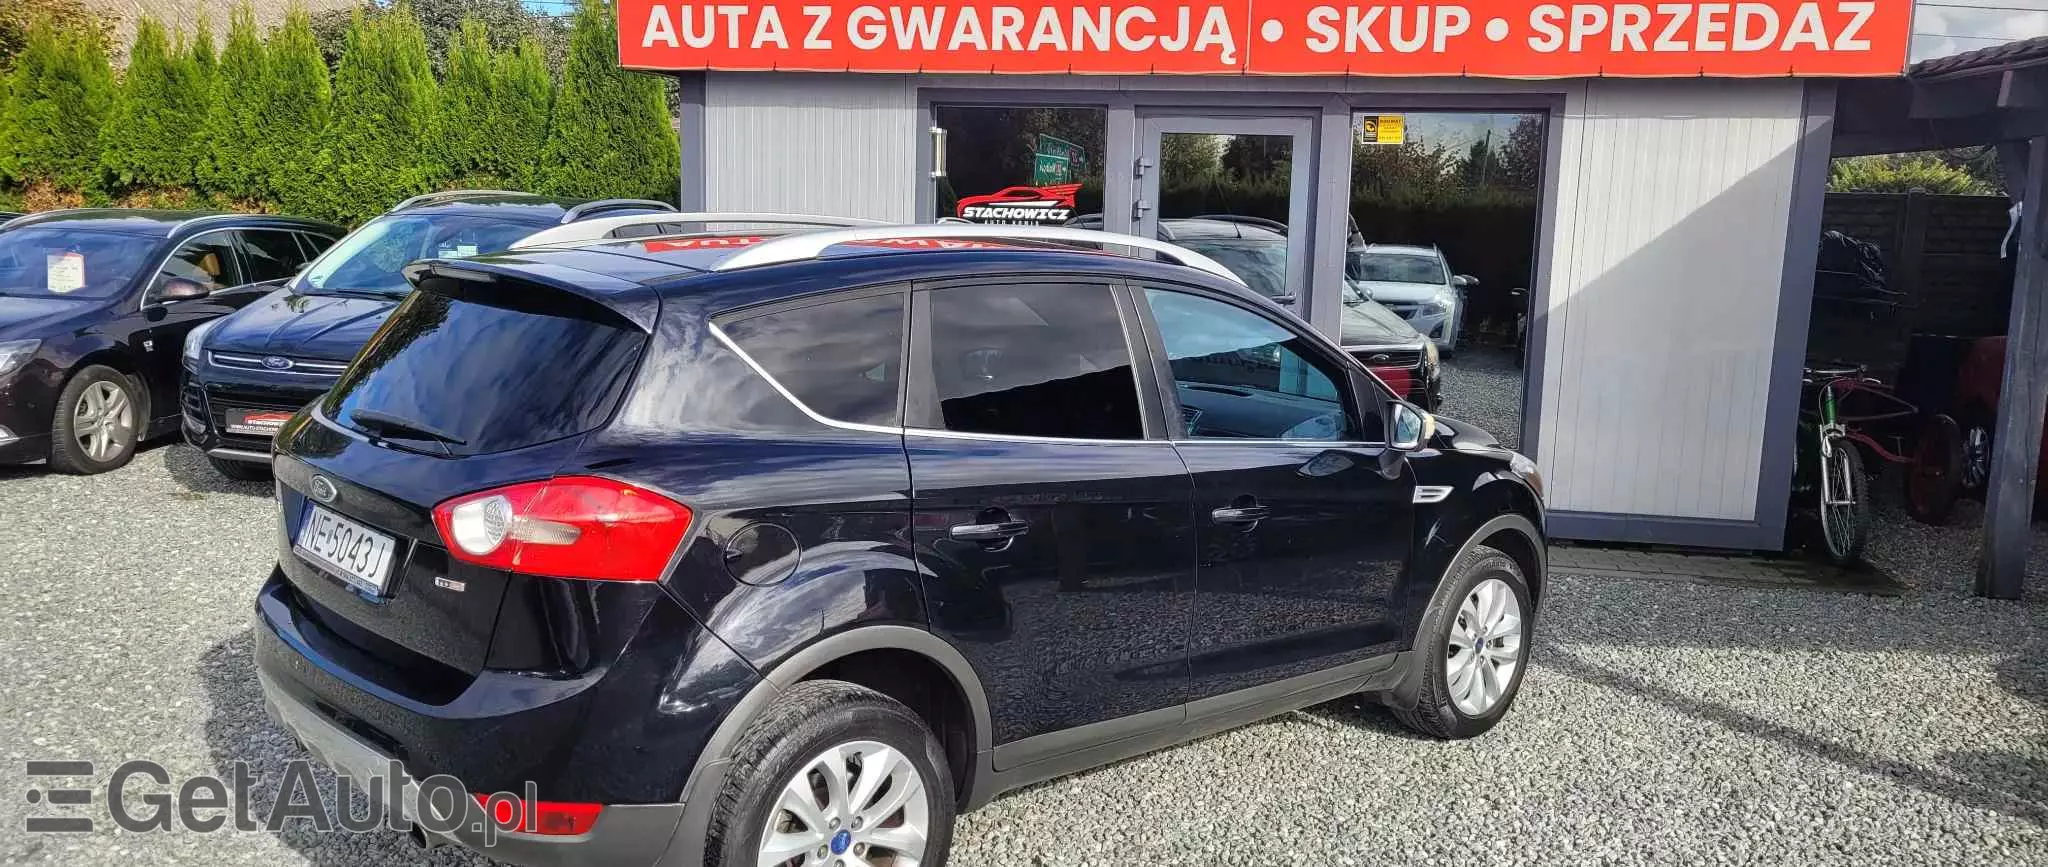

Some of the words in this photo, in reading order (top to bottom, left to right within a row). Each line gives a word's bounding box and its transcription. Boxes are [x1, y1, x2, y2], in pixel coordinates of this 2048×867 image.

[641, 6, 788, 50] AUTA
[802, 5, 832, 49] Z
[847, 5, 1236, 65] GWARANCJĄ
[1305, 4, 1470, 53] SKUP
[963, 206, 1070, 220] STACHOWICZ
[305, 517, 331, 553] NE
[328, 523, 386, 578] 5043J
